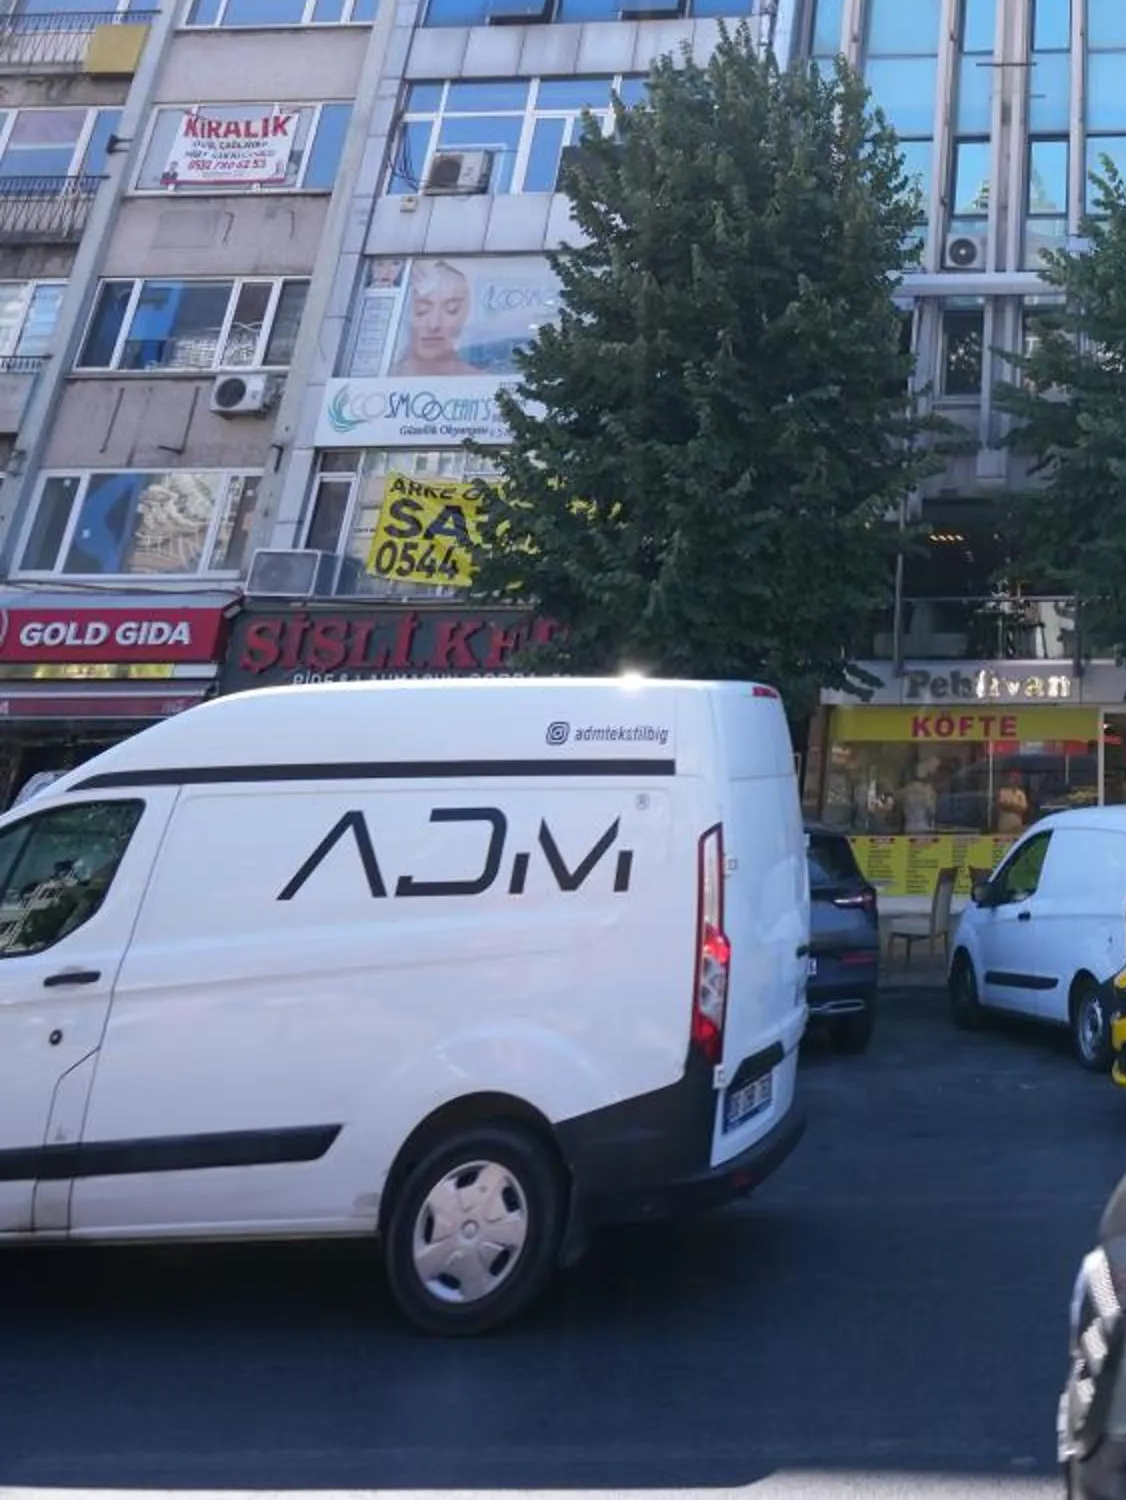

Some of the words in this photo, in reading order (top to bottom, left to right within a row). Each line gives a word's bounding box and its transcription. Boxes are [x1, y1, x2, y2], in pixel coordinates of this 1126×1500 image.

[389, 476, 457, 501] ARKE
[384, 498, 474, 546] SA
[375, 540, 460, 581] 0544
[19, 621, 110, 647] GOLD
[115, 621, 191, 646] GIDA
[911, 711, 1018, 738] KÖFTE
[276, 807, 634, 900] ADM
